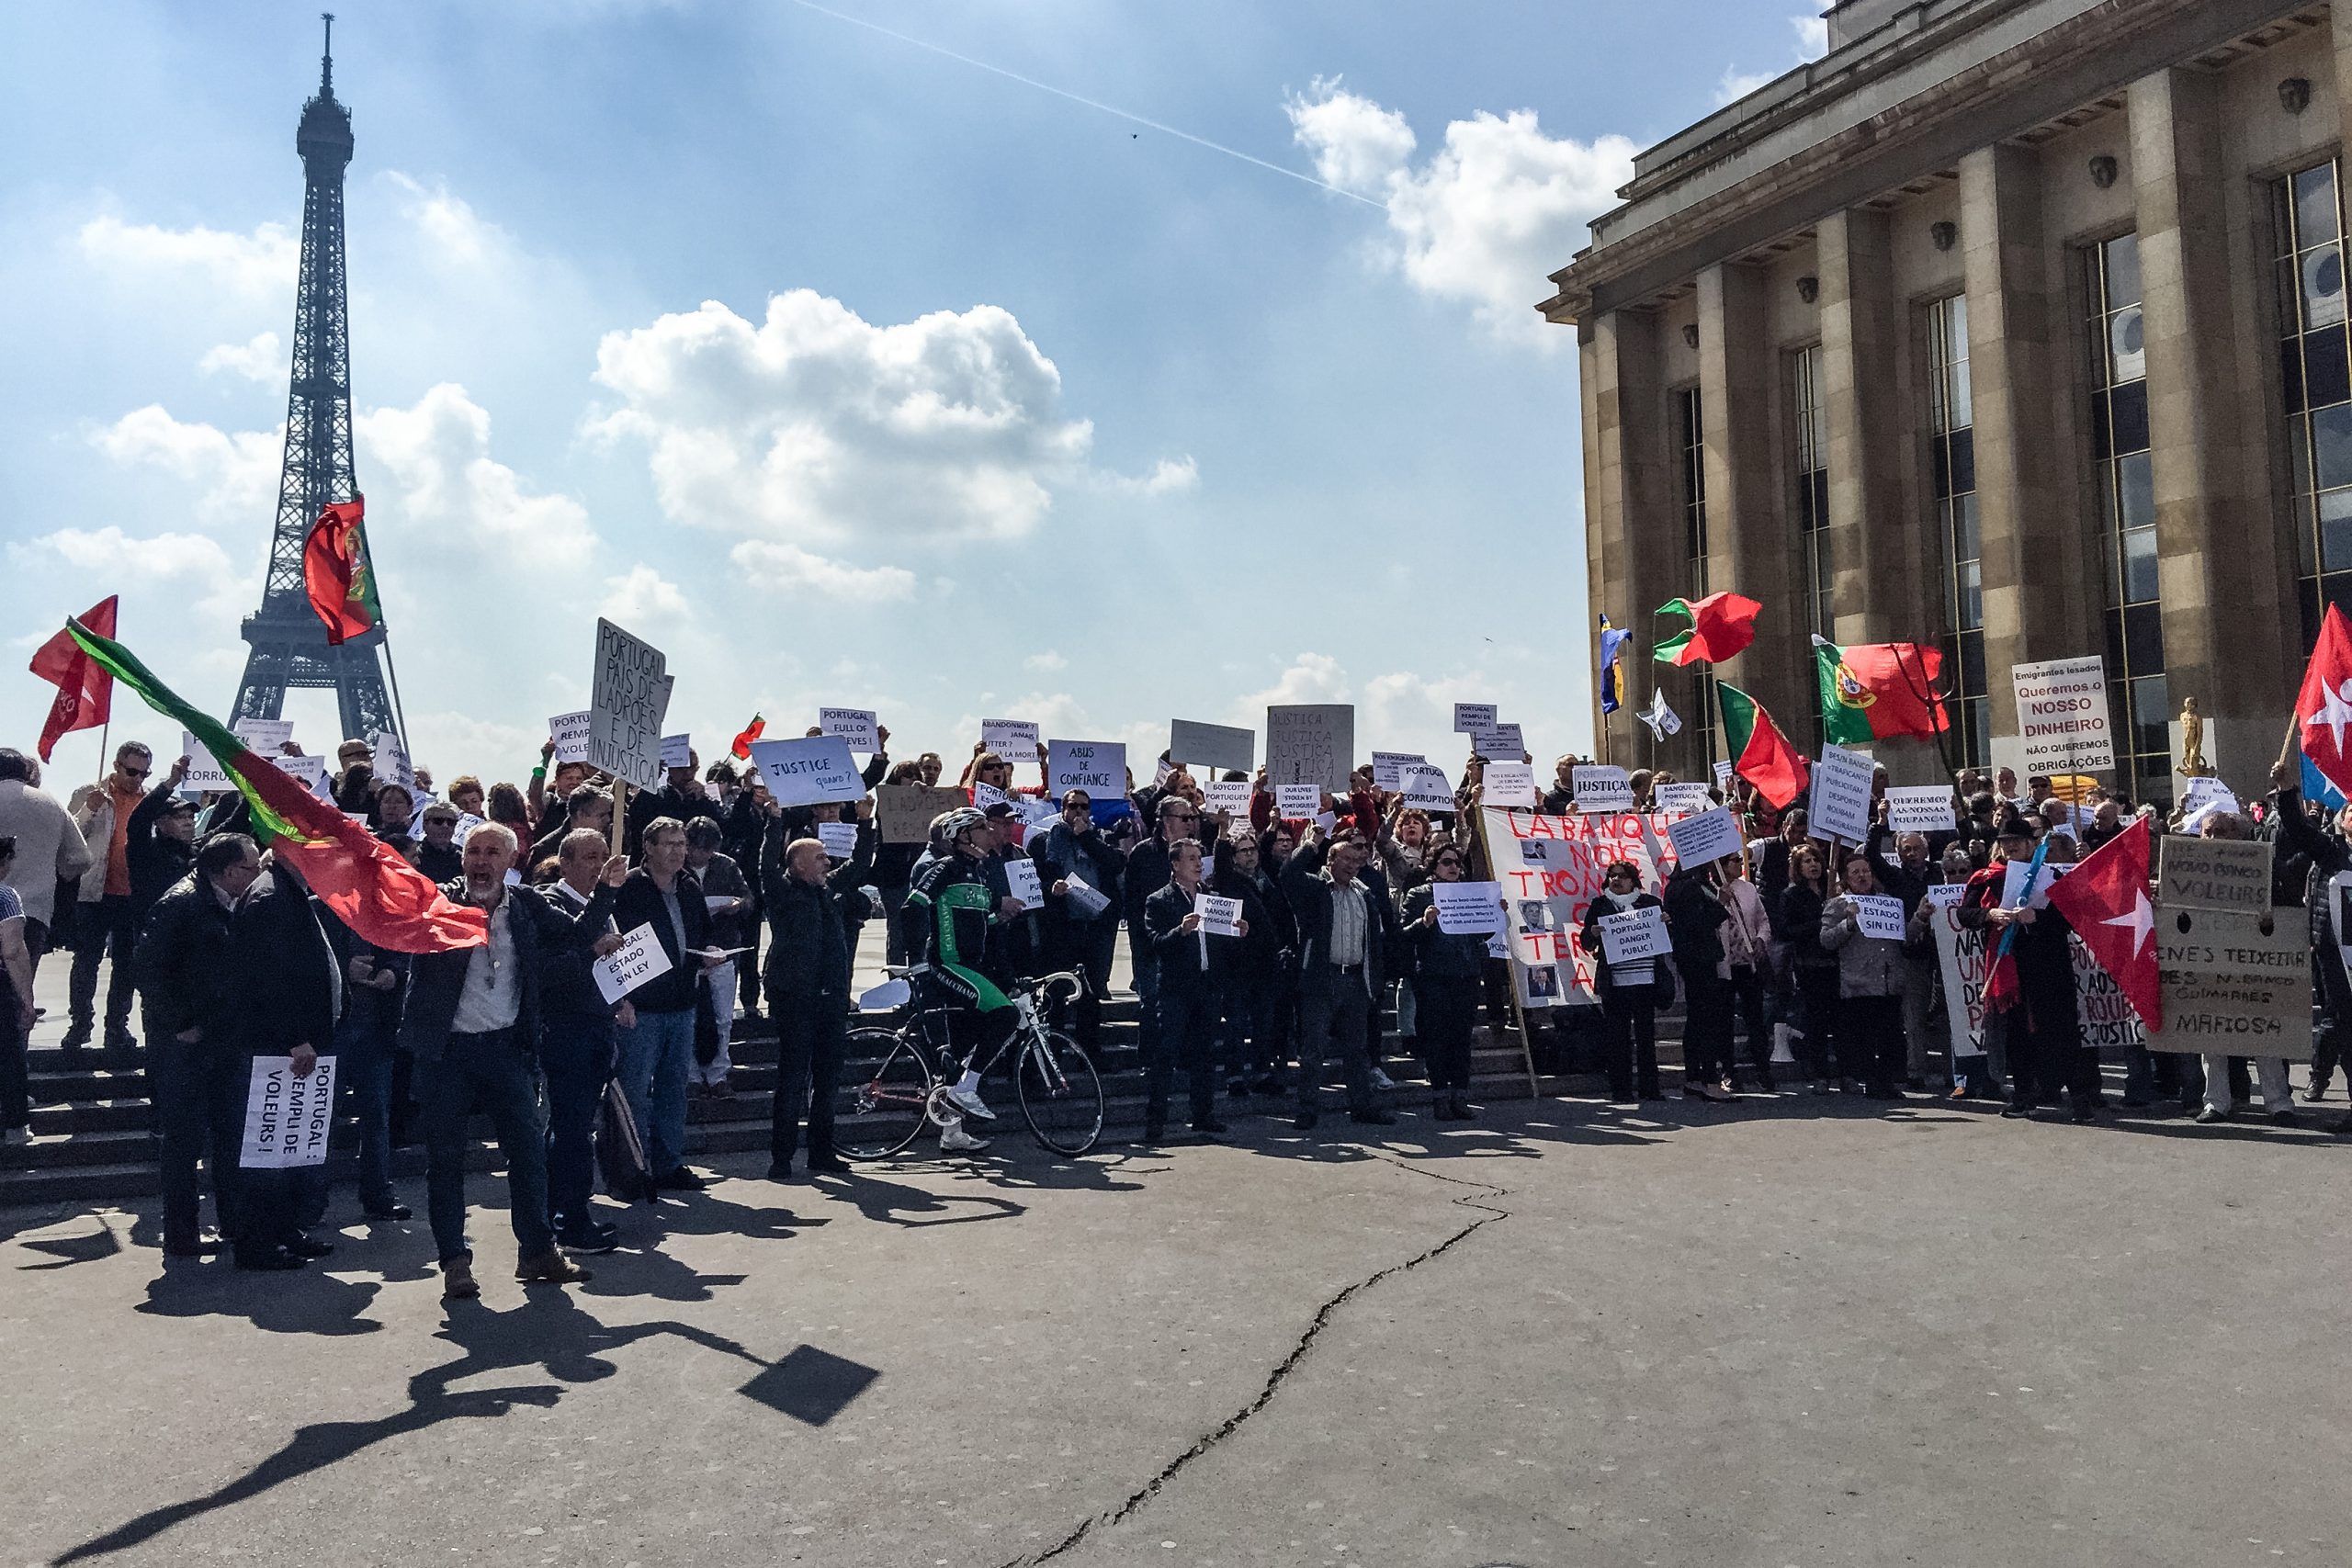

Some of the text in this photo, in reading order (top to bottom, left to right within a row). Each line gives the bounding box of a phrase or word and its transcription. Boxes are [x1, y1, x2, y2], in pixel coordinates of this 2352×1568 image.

[602, 626, 662, 683] PORTUGAL
[2016, 665, 2101, 680] Emigrantes lesados
[639, 676, 656, 707] DE
[2019, 682, 2102, 698] Queremos o
[2031, 698, 2092, 716] NOSSO
[554, 715, 590, 728] PORTU
[824, 711, 869, 721] PORTUGAL
[560, 728, 590, 740] REMP
[2025, 718, 2104, 737] DINHEIRO
[611, 717, 620, 744] E
[628, 726, 646, 756] DE
[562, 744, 589, 754] VOLE
[1069, 747, 1095, 758] ABUS
[2026, 739, 2109, 755] NÃO QUEREMOS
[771, 758, 831, 776] JUSTICE
[1080, 761, 1089, 770] DE
[1849, 758, 1870, 771] BANCO
[2029, 755, 2111, 772] OBRIGAÇÕES
[186, 771, 227, 781] CORRU
[1577, 781, 1626, 794] JUSTIÇA
[1828, 792, 1861, 807] DESPORTO
[1893, 796, 1947, 805] QUEREMOS
[1826, 805, 1855, 819] ROUBAM
[1557, 812, 1691, 844] BANQU
[1826, 817, 1865, 835] EMIGRANTES
[1510, 870, 1603, 898] TRON
[1933, 886, 1966, 896] PORTU
[2170, 878, 2267, 904] VOLEURS
[1027, 895, 1042, 903] THR
[1207, 898, 1235, 907] BOYCOTT
[1851, 897, 1901, 908] PORTUGAL
[1944, 898, 1962, 907] EST
[1205, 908, 1234, 917] BANQUES
[1609, 912, 1640, 924] BANQUE
[1864, 908, 1900, 919] ESTADO
[1611, 921, 1651, 935] PORTUGAL
[1866, 920, 1900, 931] SIN LEY
[1620, 933, 1651, 945] DANGER
[1622, 944, 1648, 955] PUBLIC
[608, 948, 645, 974] ESTADO
[616, 961, 650, 986] SIN LEY
[936, 972, 978, 999] BEAUCHAMP
[2085, 994, 2132, 1021] ROUB
[2176, 1014, 2281, 1035] MAFIOSA
[260, 1070, 282, 1142] VOLEURS
[308, 1065, 330, 1150] PORTUGAL
[283, 1134, 299, 1154] DE
